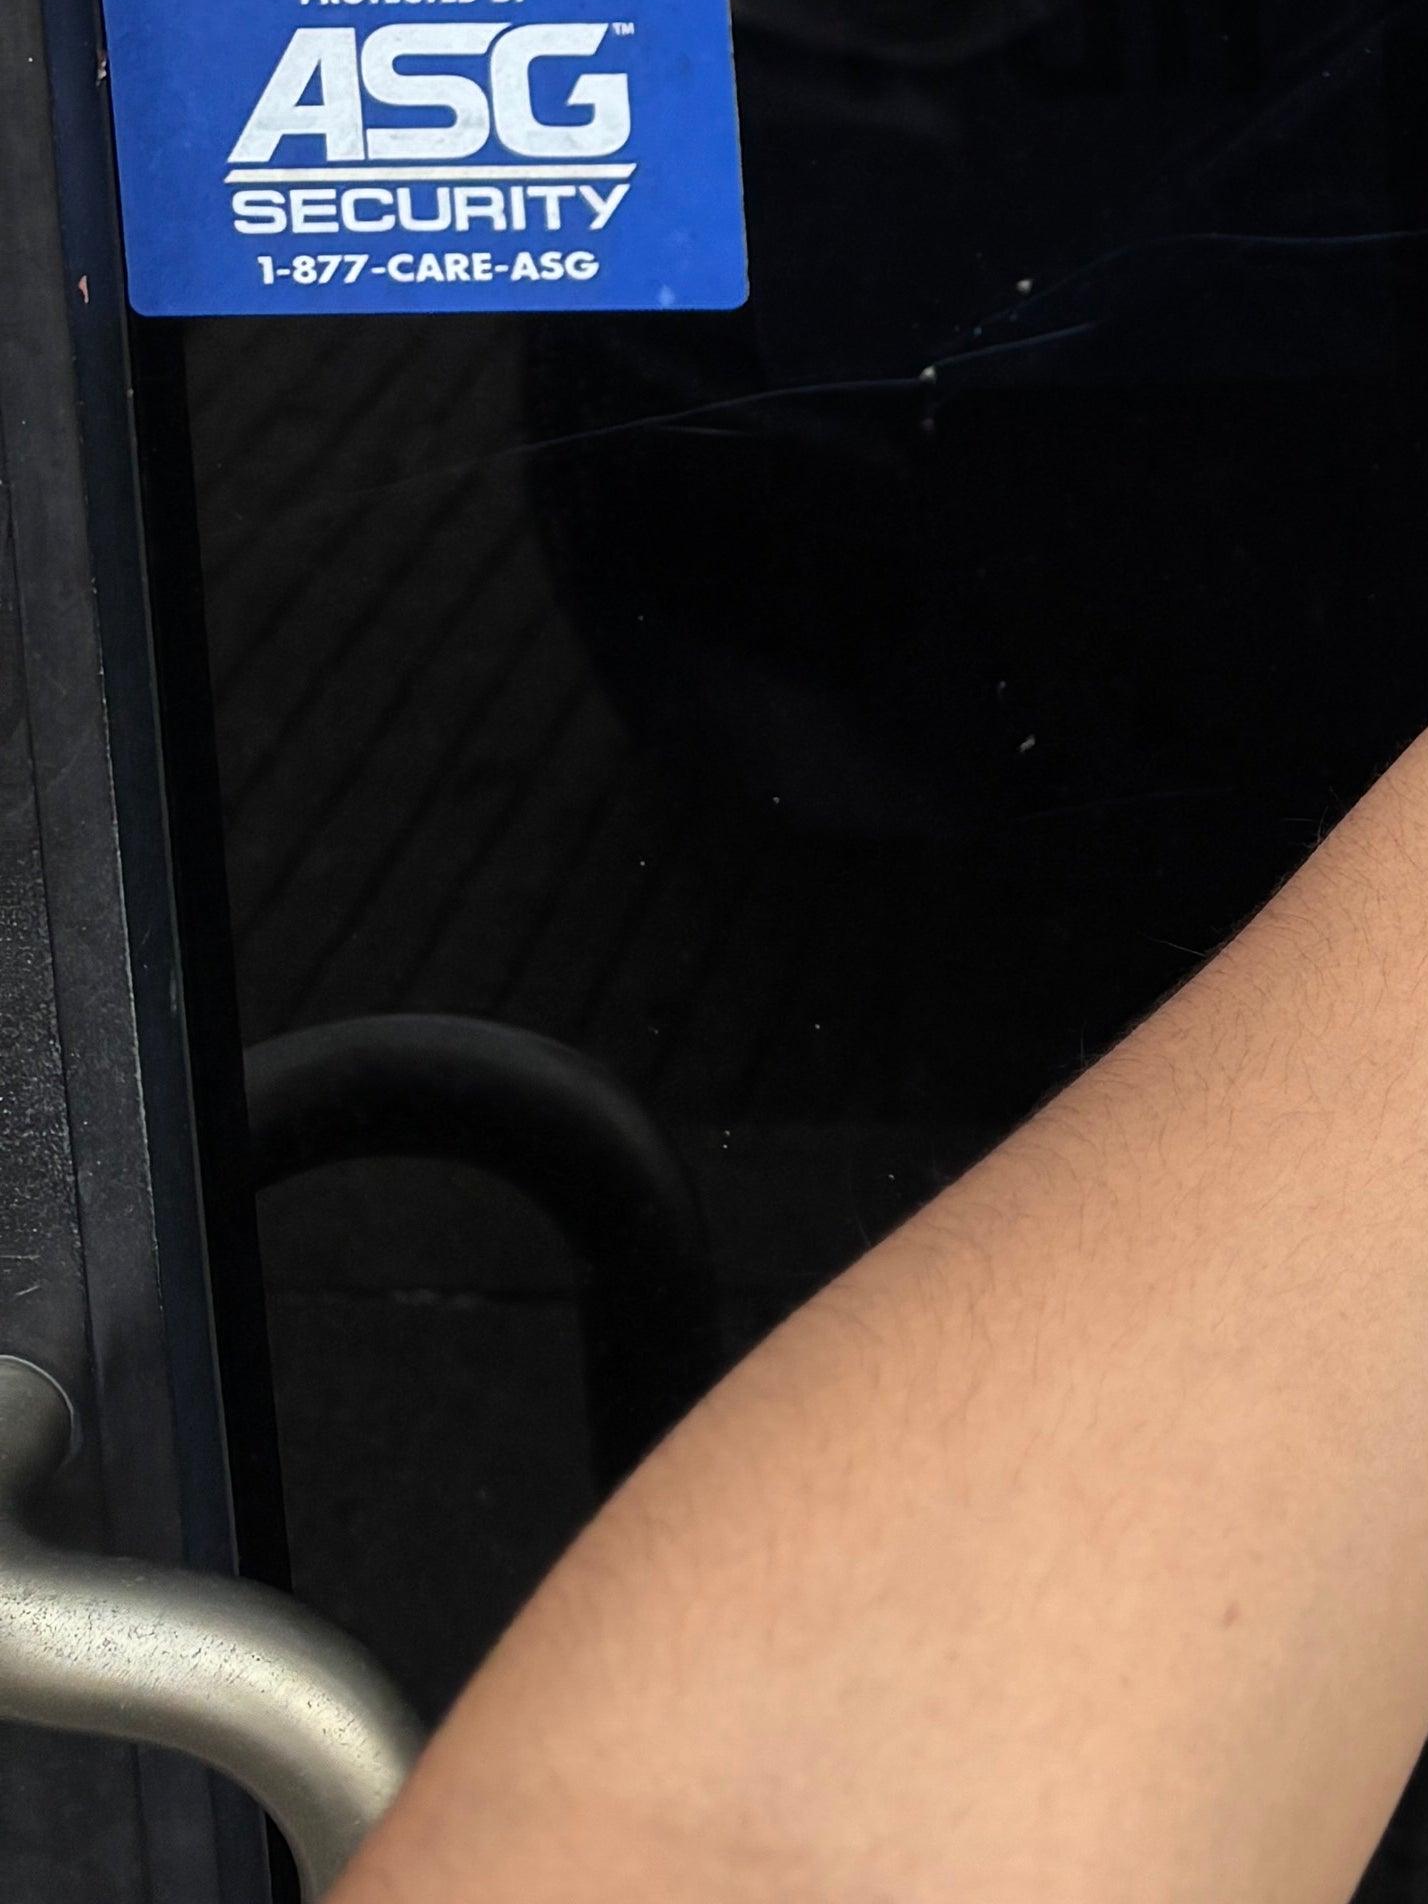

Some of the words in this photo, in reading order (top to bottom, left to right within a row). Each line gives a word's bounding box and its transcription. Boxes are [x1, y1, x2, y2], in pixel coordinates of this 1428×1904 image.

[226, 21, 632, 163] ASG
[231, 183, 631, 235] SECURITY
[257, 250, 599, 285] 1-877-CARE-ASG
